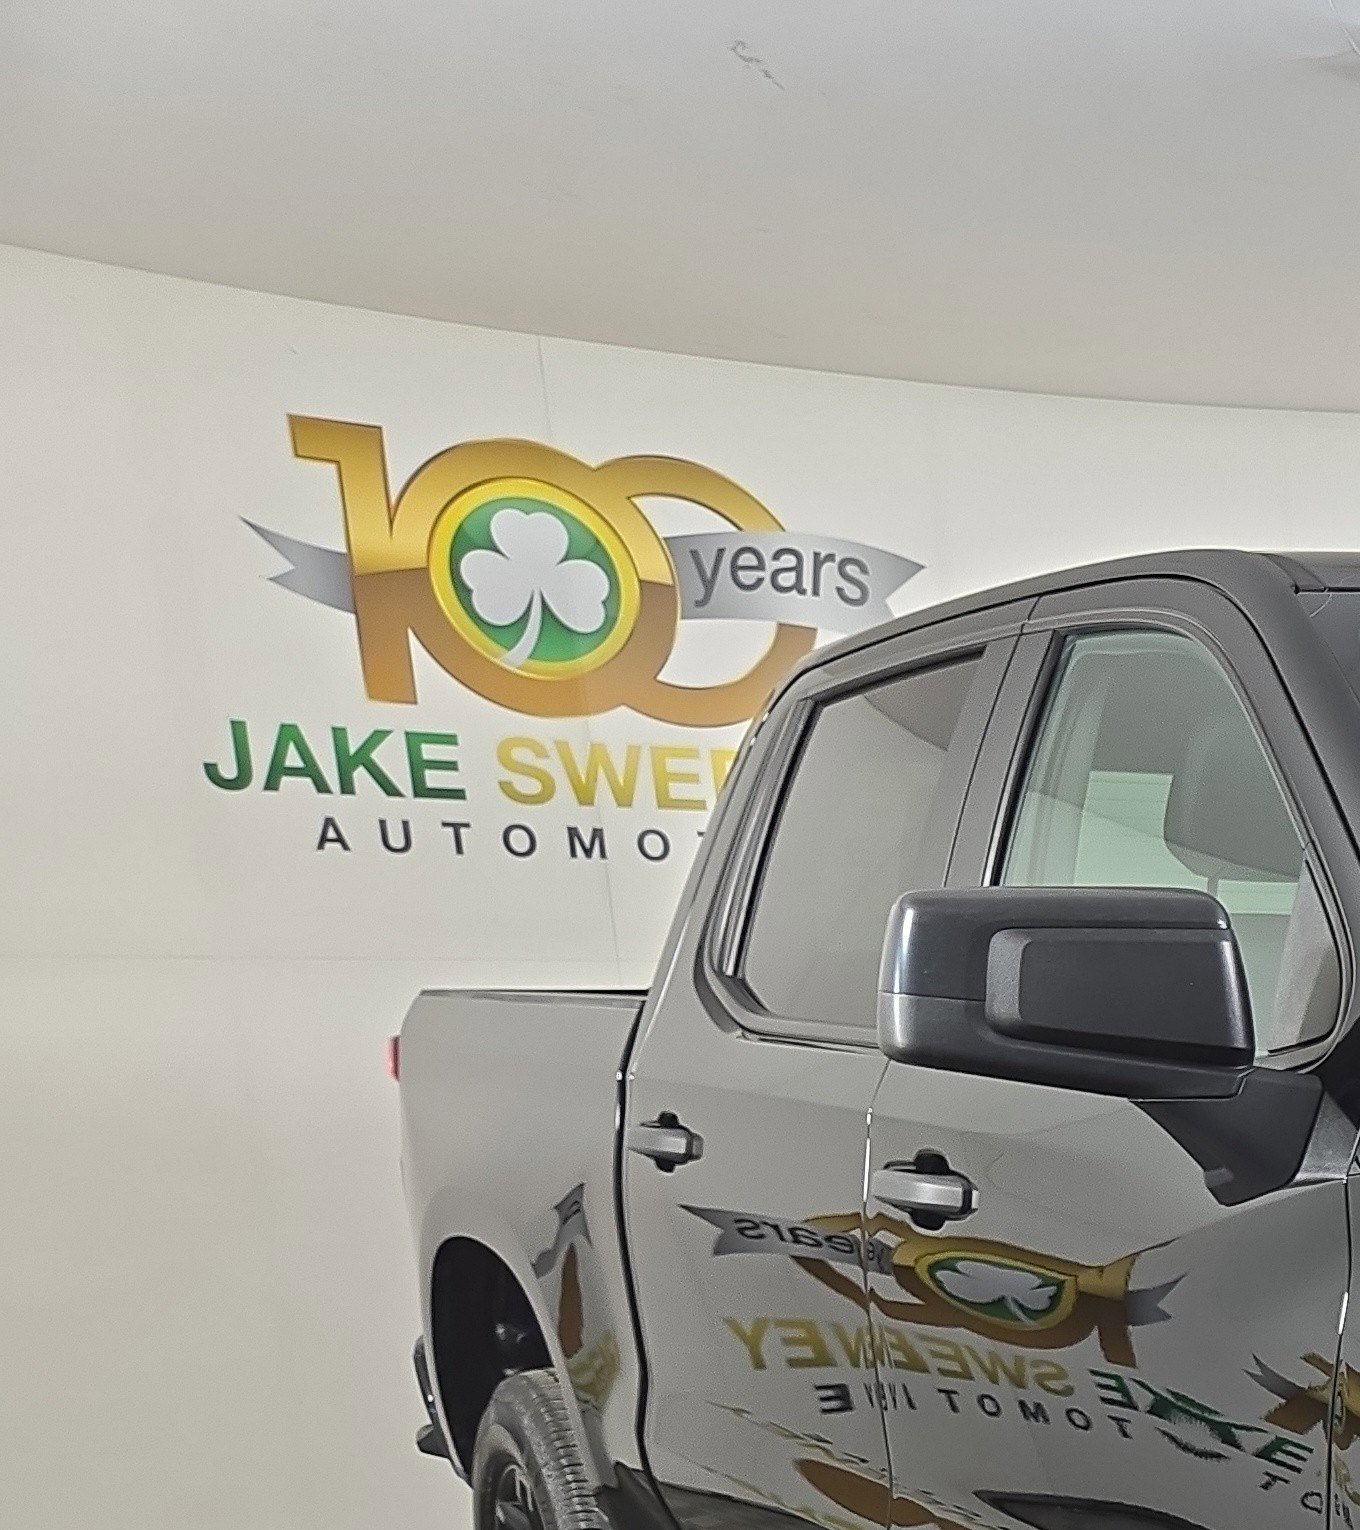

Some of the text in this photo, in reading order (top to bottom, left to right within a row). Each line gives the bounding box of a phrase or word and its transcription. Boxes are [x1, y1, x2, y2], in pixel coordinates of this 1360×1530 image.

[689, 544, 872, 608] years
[202, 719, 468, 801] JAKE
[316, 816, 705, 863] AUTOMO
